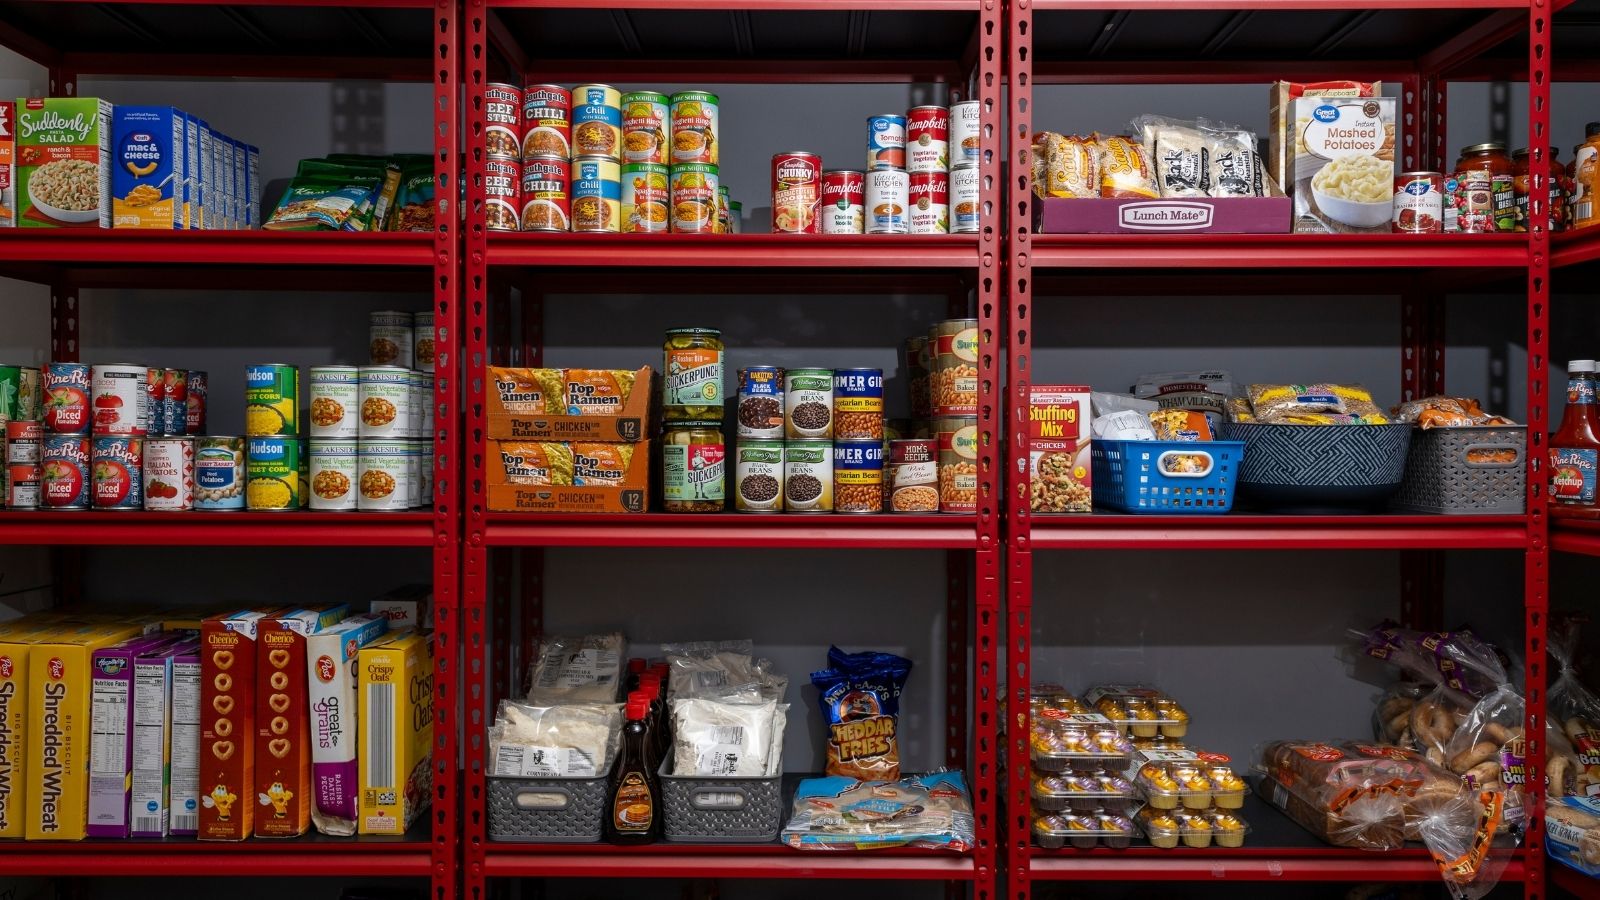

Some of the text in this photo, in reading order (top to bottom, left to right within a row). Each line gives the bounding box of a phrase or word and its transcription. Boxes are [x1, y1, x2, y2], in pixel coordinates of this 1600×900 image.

[487, 114, 516, 124] STEW
[526, 109, 564, 119] CHILI
[20, 111, 96, 141] Suddenly!
[907, 117, 946, 131] Campbell's
[1328, 128, 1375, 138] Mashed
[1325, 140, 1375, 149] Potatoes
[1162, 150, 1192, 190] Jack
[1190, 153, 1200, 186] Beanstalk
[1242, 150, 1252, 182] Beanstalk
[779, 169, 812, 178] CHUNKY
[1215, 151, 1251, 195] Jack
[524, 181, 560, 191] CHILI
[1517, 196, 1529, 205] TOM
[1133, 211, 1168, 220] Lunch
[44, 373, 70, 388] Vine
[667, 365, 718, 388] SUCKERPUNCH
[379, 385, 406, 393] Vegetables
[569, 383, 595, 397] Top
[1576, 383, 1593, 395] Ripe
[570, 394, 618, 404] Ramen
[1188, 397, 1223, 407] VILLAGE
[503, 403, 536, 411] CHICKEN
[582, 405, 614, 413] CHICKEN
[56, 410, 81, 420] Diced
[1030, 405, 1076, 423] Stuffing
[512, 419, 532, 428] Top
[554, 422, 591, 431] CHICKEN
[624, 422, 634, 433] 12
[512, 428, 551, 436] Ramen
[1041, 422, 1064, 437] Mix
[62, 443, 89, 462] Ripe
[110, 443, 138, 462] Ripe
[250, 441, 283, 454] Hudson
[906, 444, 928, 453] MOM'S
[502, 454, 524, 466] Top
[575, 455, 599, 467] Top
[904, 453, 929, 461] RECIPE
[1551, 453, 1592, 469] Vine Ripe
[574, 466, 622, 478] Ramen
[48, 483, 72, 492] Diced
[98, 483, 119, 492] Diced
[1553, 477, 1583, 488] Ketchup
[516, 491, 536, 499] Top
[558, 493, 595, 503] CHICKEN
[628, 494, 639, 505] 12
[516, 500, 555, 508] Ramen
[208, 634, 239, 645] Cheerios
[264, 632, 294, 644] Cheerios
[0, 657, 13, 676] Post
[51, 657, 63, 676] Post
[321, 658, 335, 679] Post
[368, 665, 394, 675] Crispy
[371, 673, 390, 681] Oats
[327, 696, 342, 735] great
[0, 681, 14, 763] Shredded
[313, 697, 331, 748] grains
[841, 737, 888, 761] FRIES
[41, 682, 65, 832] Shredded Wheat
